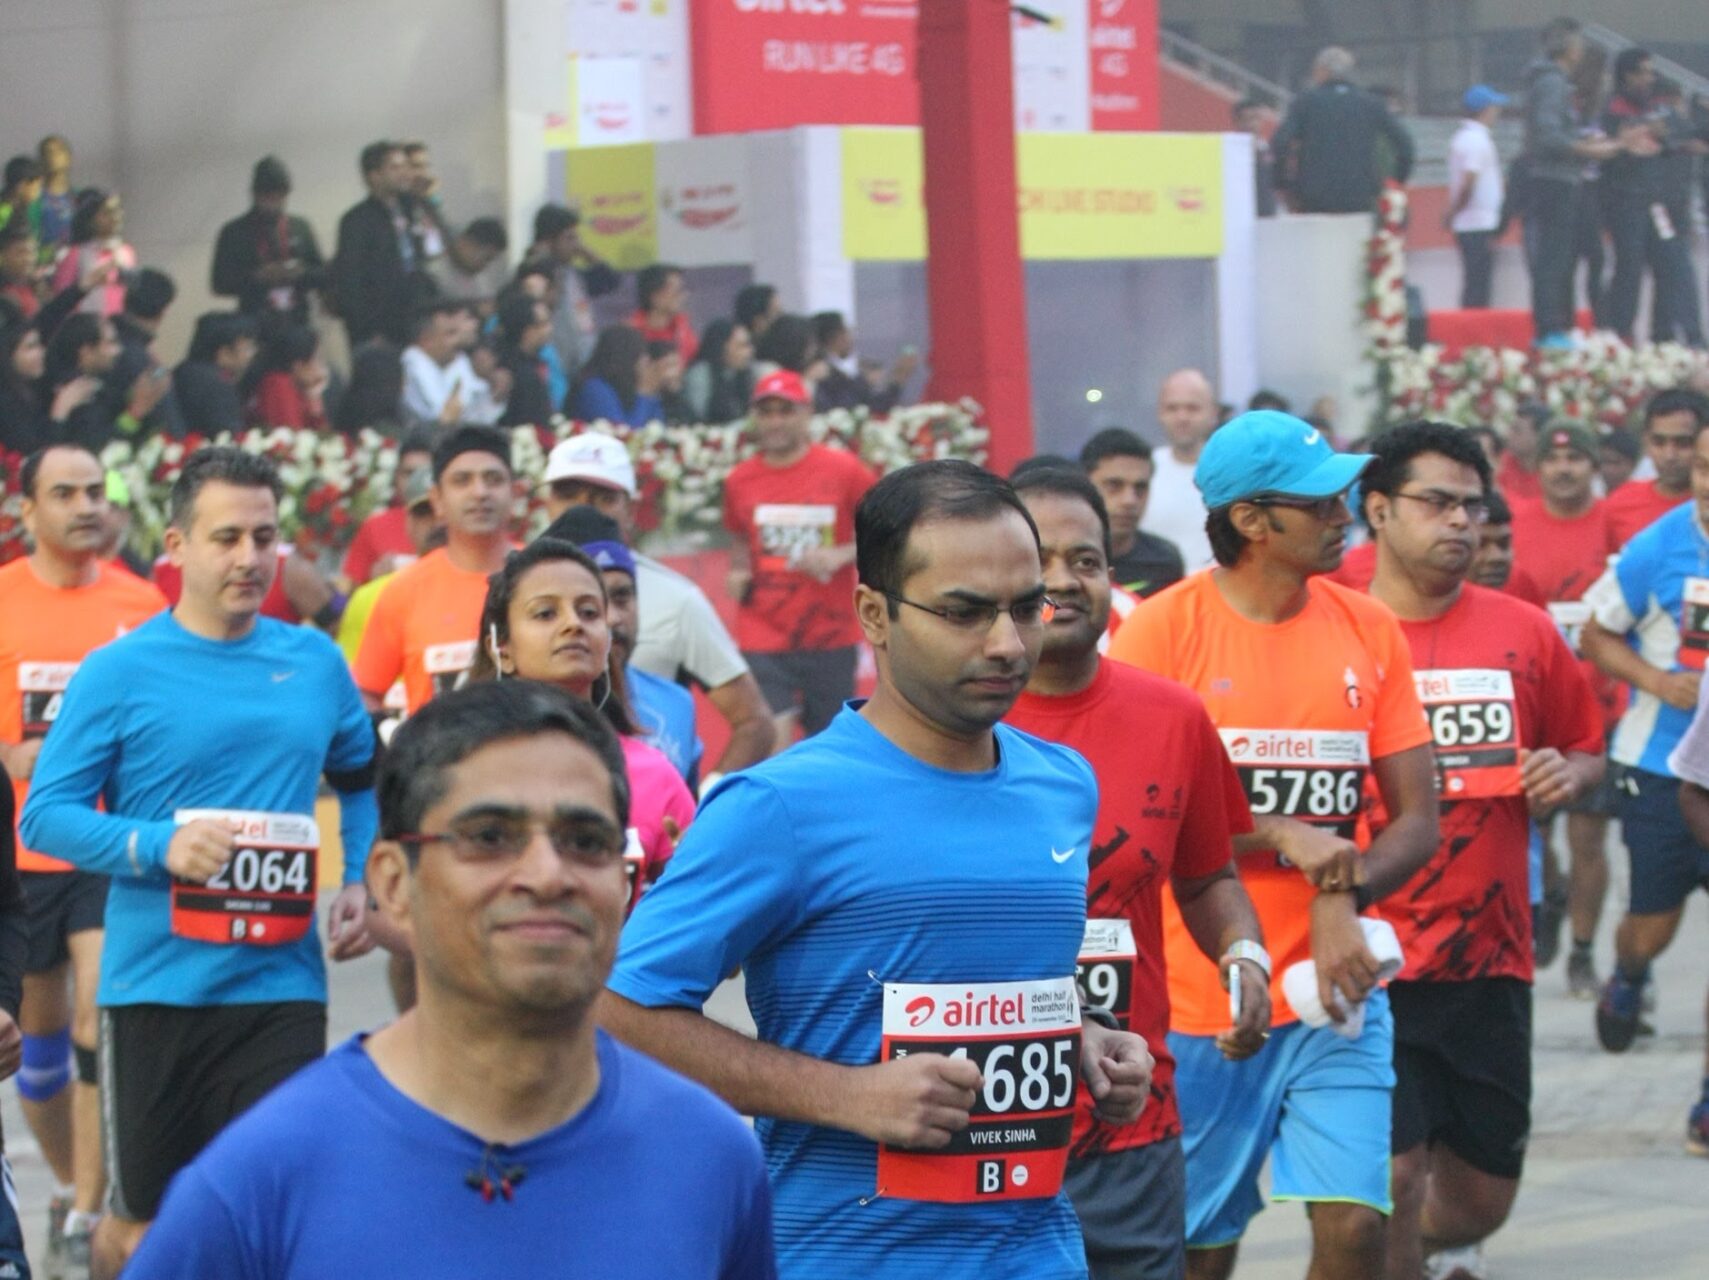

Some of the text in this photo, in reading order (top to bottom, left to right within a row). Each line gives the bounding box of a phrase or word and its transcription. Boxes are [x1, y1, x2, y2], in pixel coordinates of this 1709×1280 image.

[1424, 702, 1512, 747] 659
[1256, 737, 1314, 758] airtel
[1251, 769, 1358, 815] 5786
[1077, 964, 1119, 1011] 9
[943, 992, 1025, 1027] airtel
[949, 1040, 1073, 1112] 685
[970, 1129, 1036, 1144] VIVEK SINHA
[983, 1162, 999, 1192] B
